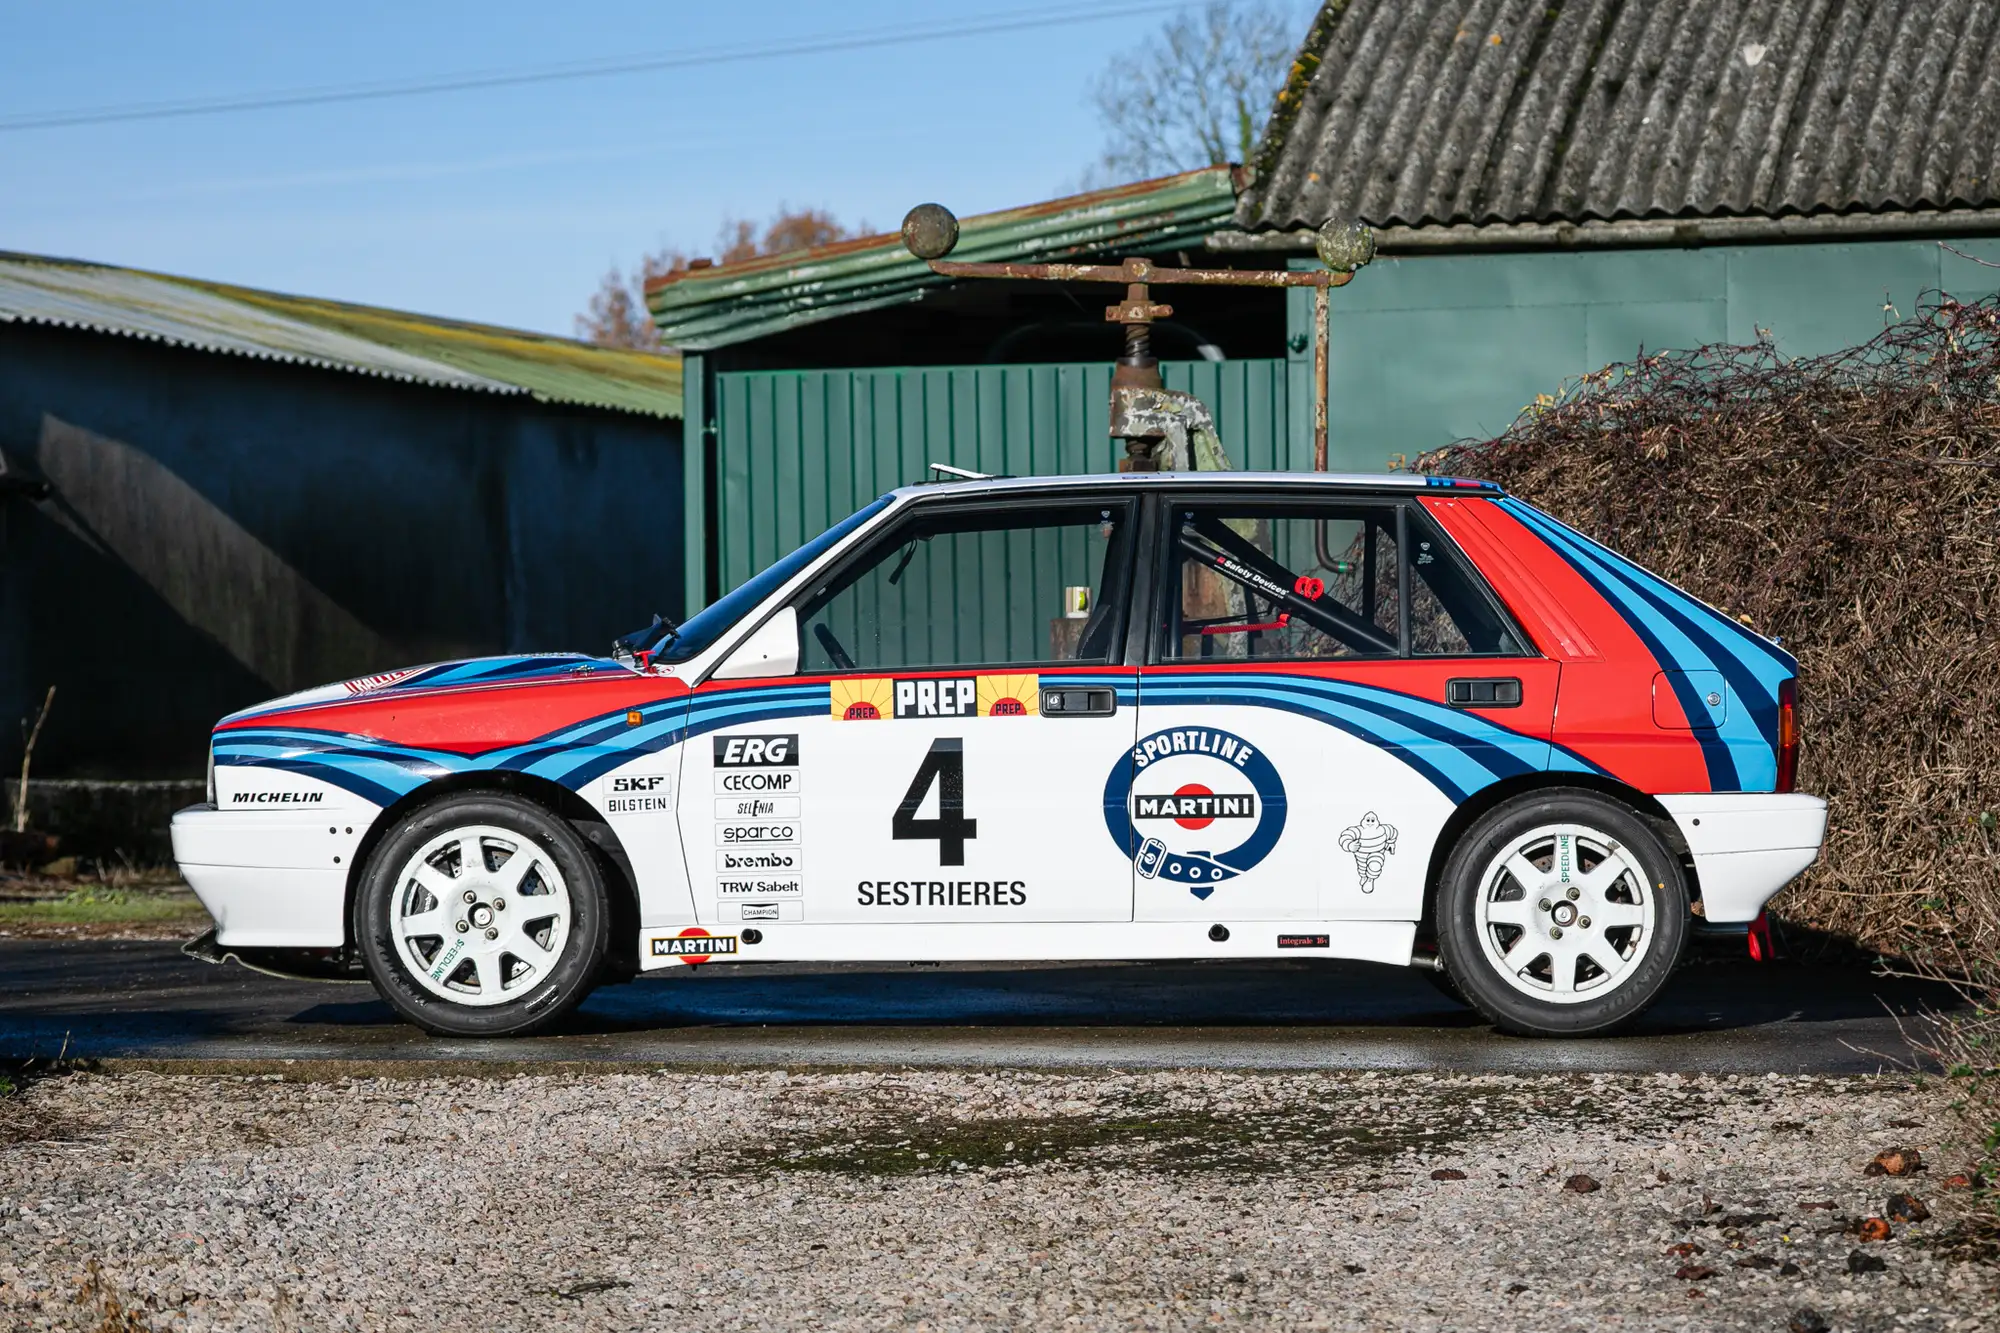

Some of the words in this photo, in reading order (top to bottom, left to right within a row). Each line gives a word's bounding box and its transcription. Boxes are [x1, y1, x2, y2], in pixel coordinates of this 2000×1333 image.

[1224, 560, 1253, 578] Safety
[1252, 574, 1287, 596] Devices
[896, 679, 975, 716] PREP
[849, 707, 875, 719] PREP
[995, 703, 1021, 715] PREP
[722, 738, 789, 764] ERG
[1132, 730, 1253, 767] SPORTLINE
[613, 776, 665, 791] SKF
[723, 774, 792, 790] CECOMP
[232, 792, 323, 803] MICHELIN
[608, 797, 666, 812] BILSTEIN
[892, 737, 977, 866] 4
[737, 800, 774, 817] SELENIA
[1139, 798, 1250, 816] MARTINI
[723, 826, 793, 843] sparco
[725, 853, 793, 868] brembo
[1561, 835, 1570, 883] SPEEDLINE
[720, 882, 753, 893] TRW
[756, 881, 799, 893] Sabelt
[857, 880, 1027, 906] SESTRIERES
[743, 908, 778, 916] CHAMPION
[654, 938, 735, 954] MARTINI
[1279, 937, 1313, 946] integrale
[431, 938, 465, 981] SPEEDLINE
